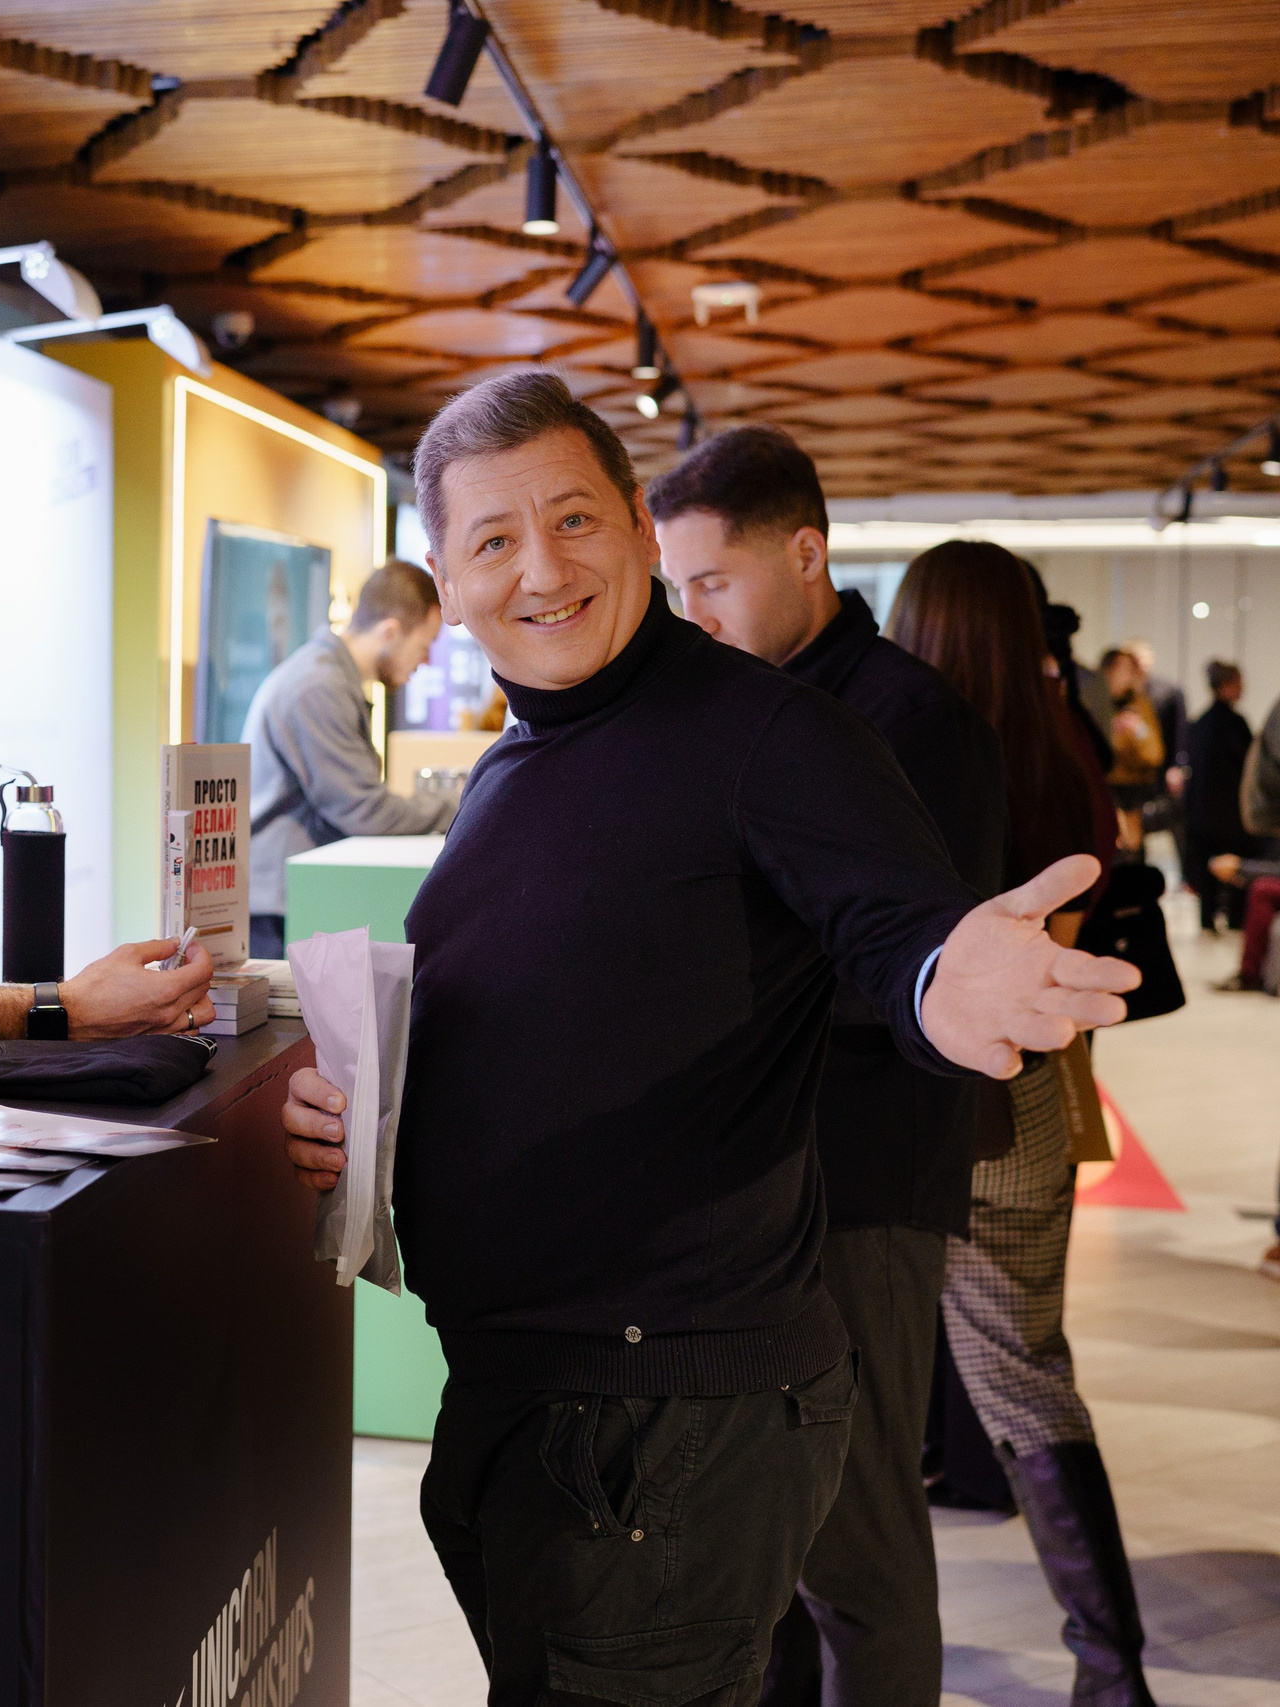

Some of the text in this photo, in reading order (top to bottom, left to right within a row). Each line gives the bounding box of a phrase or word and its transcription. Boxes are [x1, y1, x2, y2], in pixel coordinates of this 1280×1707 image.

[194, 778, 237, 804] ПРОСТО
[194, 803, 236, 838] ДЕЛАЙ!
[193, 832, 236, 867] ДЕЛАЙ
[193, 865, 236, 893] ПРОСТО!
[192, 1526, 277, 1707] UNICORN
